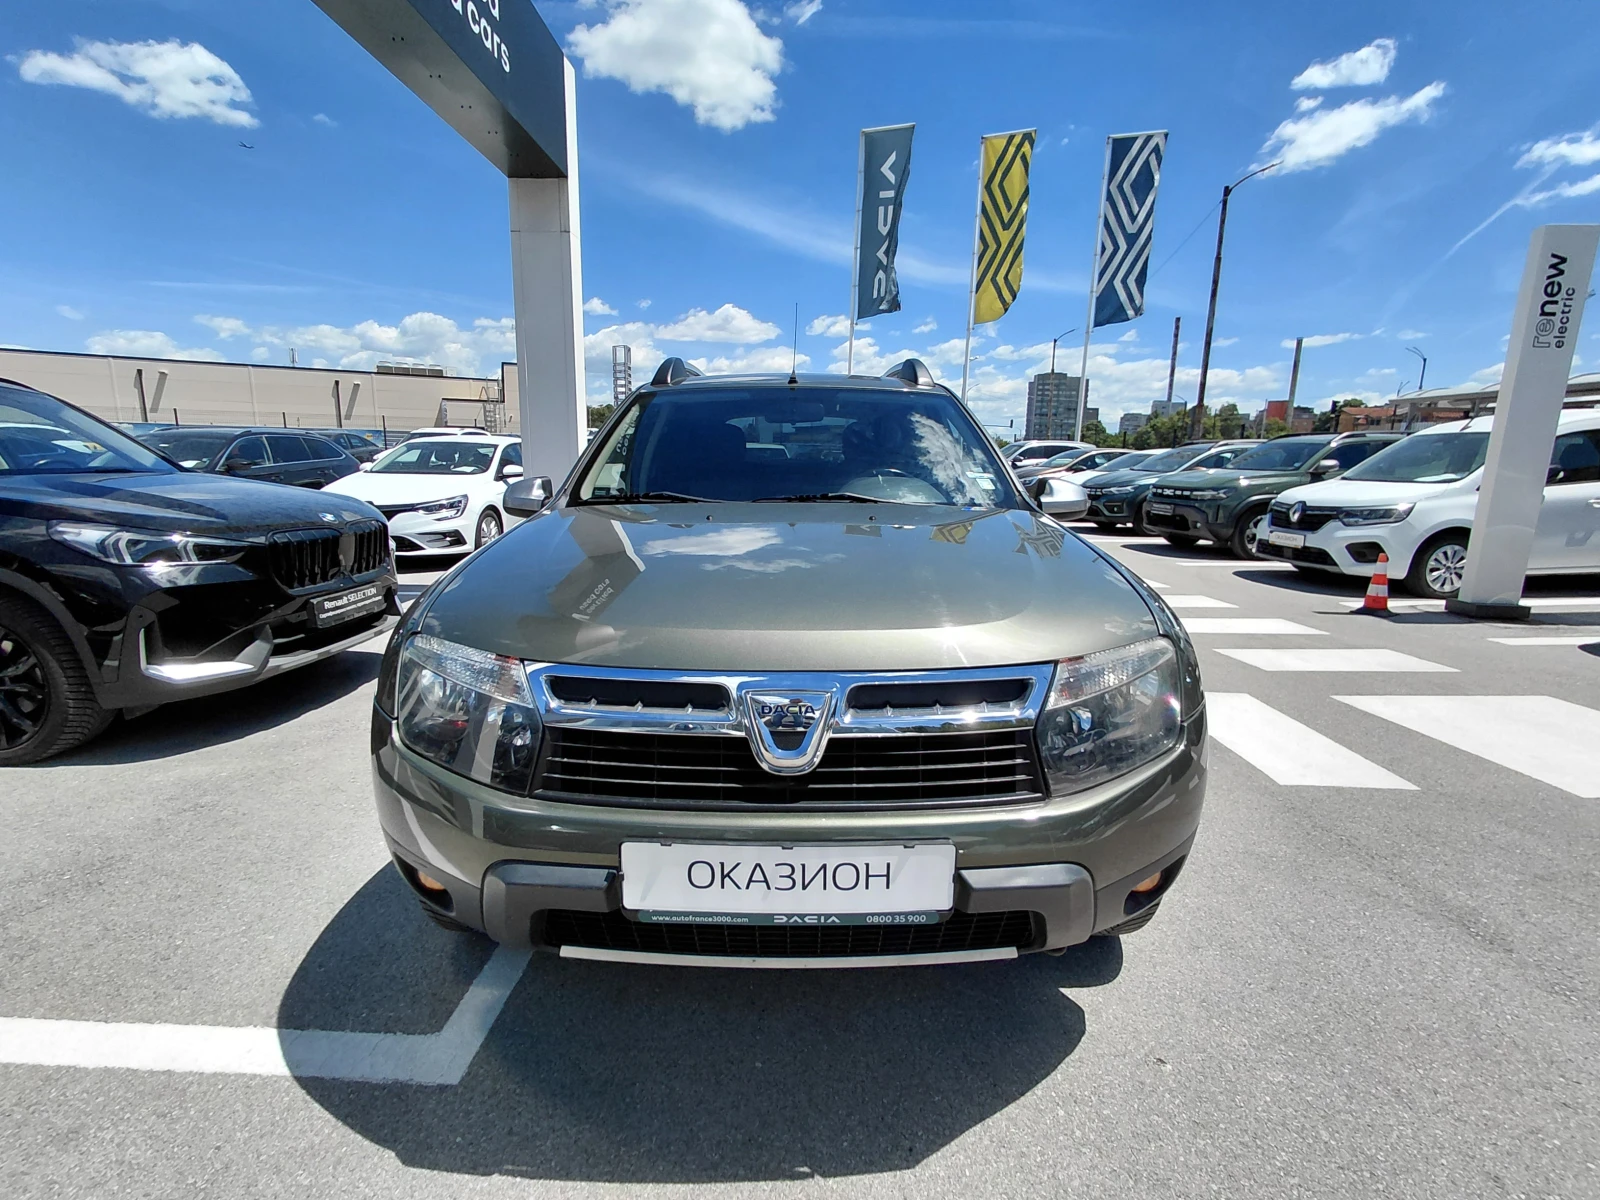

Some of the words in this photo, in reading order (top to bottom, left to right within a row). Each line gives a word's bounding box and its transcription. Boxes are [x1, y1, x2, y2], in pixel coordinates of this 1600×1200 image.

[467, 0, 510, 73] cars
[872, 150, 897, 299] DACIA
[1532, 252, 1568, 348] renew
[1553, 287, 1575, 349] electric
[324, 596, 347, 609] Renault
[347, 587, 376, 602] SELECTION
[761, 705, 816, 715] DACIA
[687, 860, 891, 891] ОКАЗИОН
[651, 914, 749, 923] www.autofrance3000.com
[773, 915, 841, 923] DACIA
[866, 915, 892, 923] 0800
[893, 915, 906, 923] 35
[907, 914, 927, 923] 900
